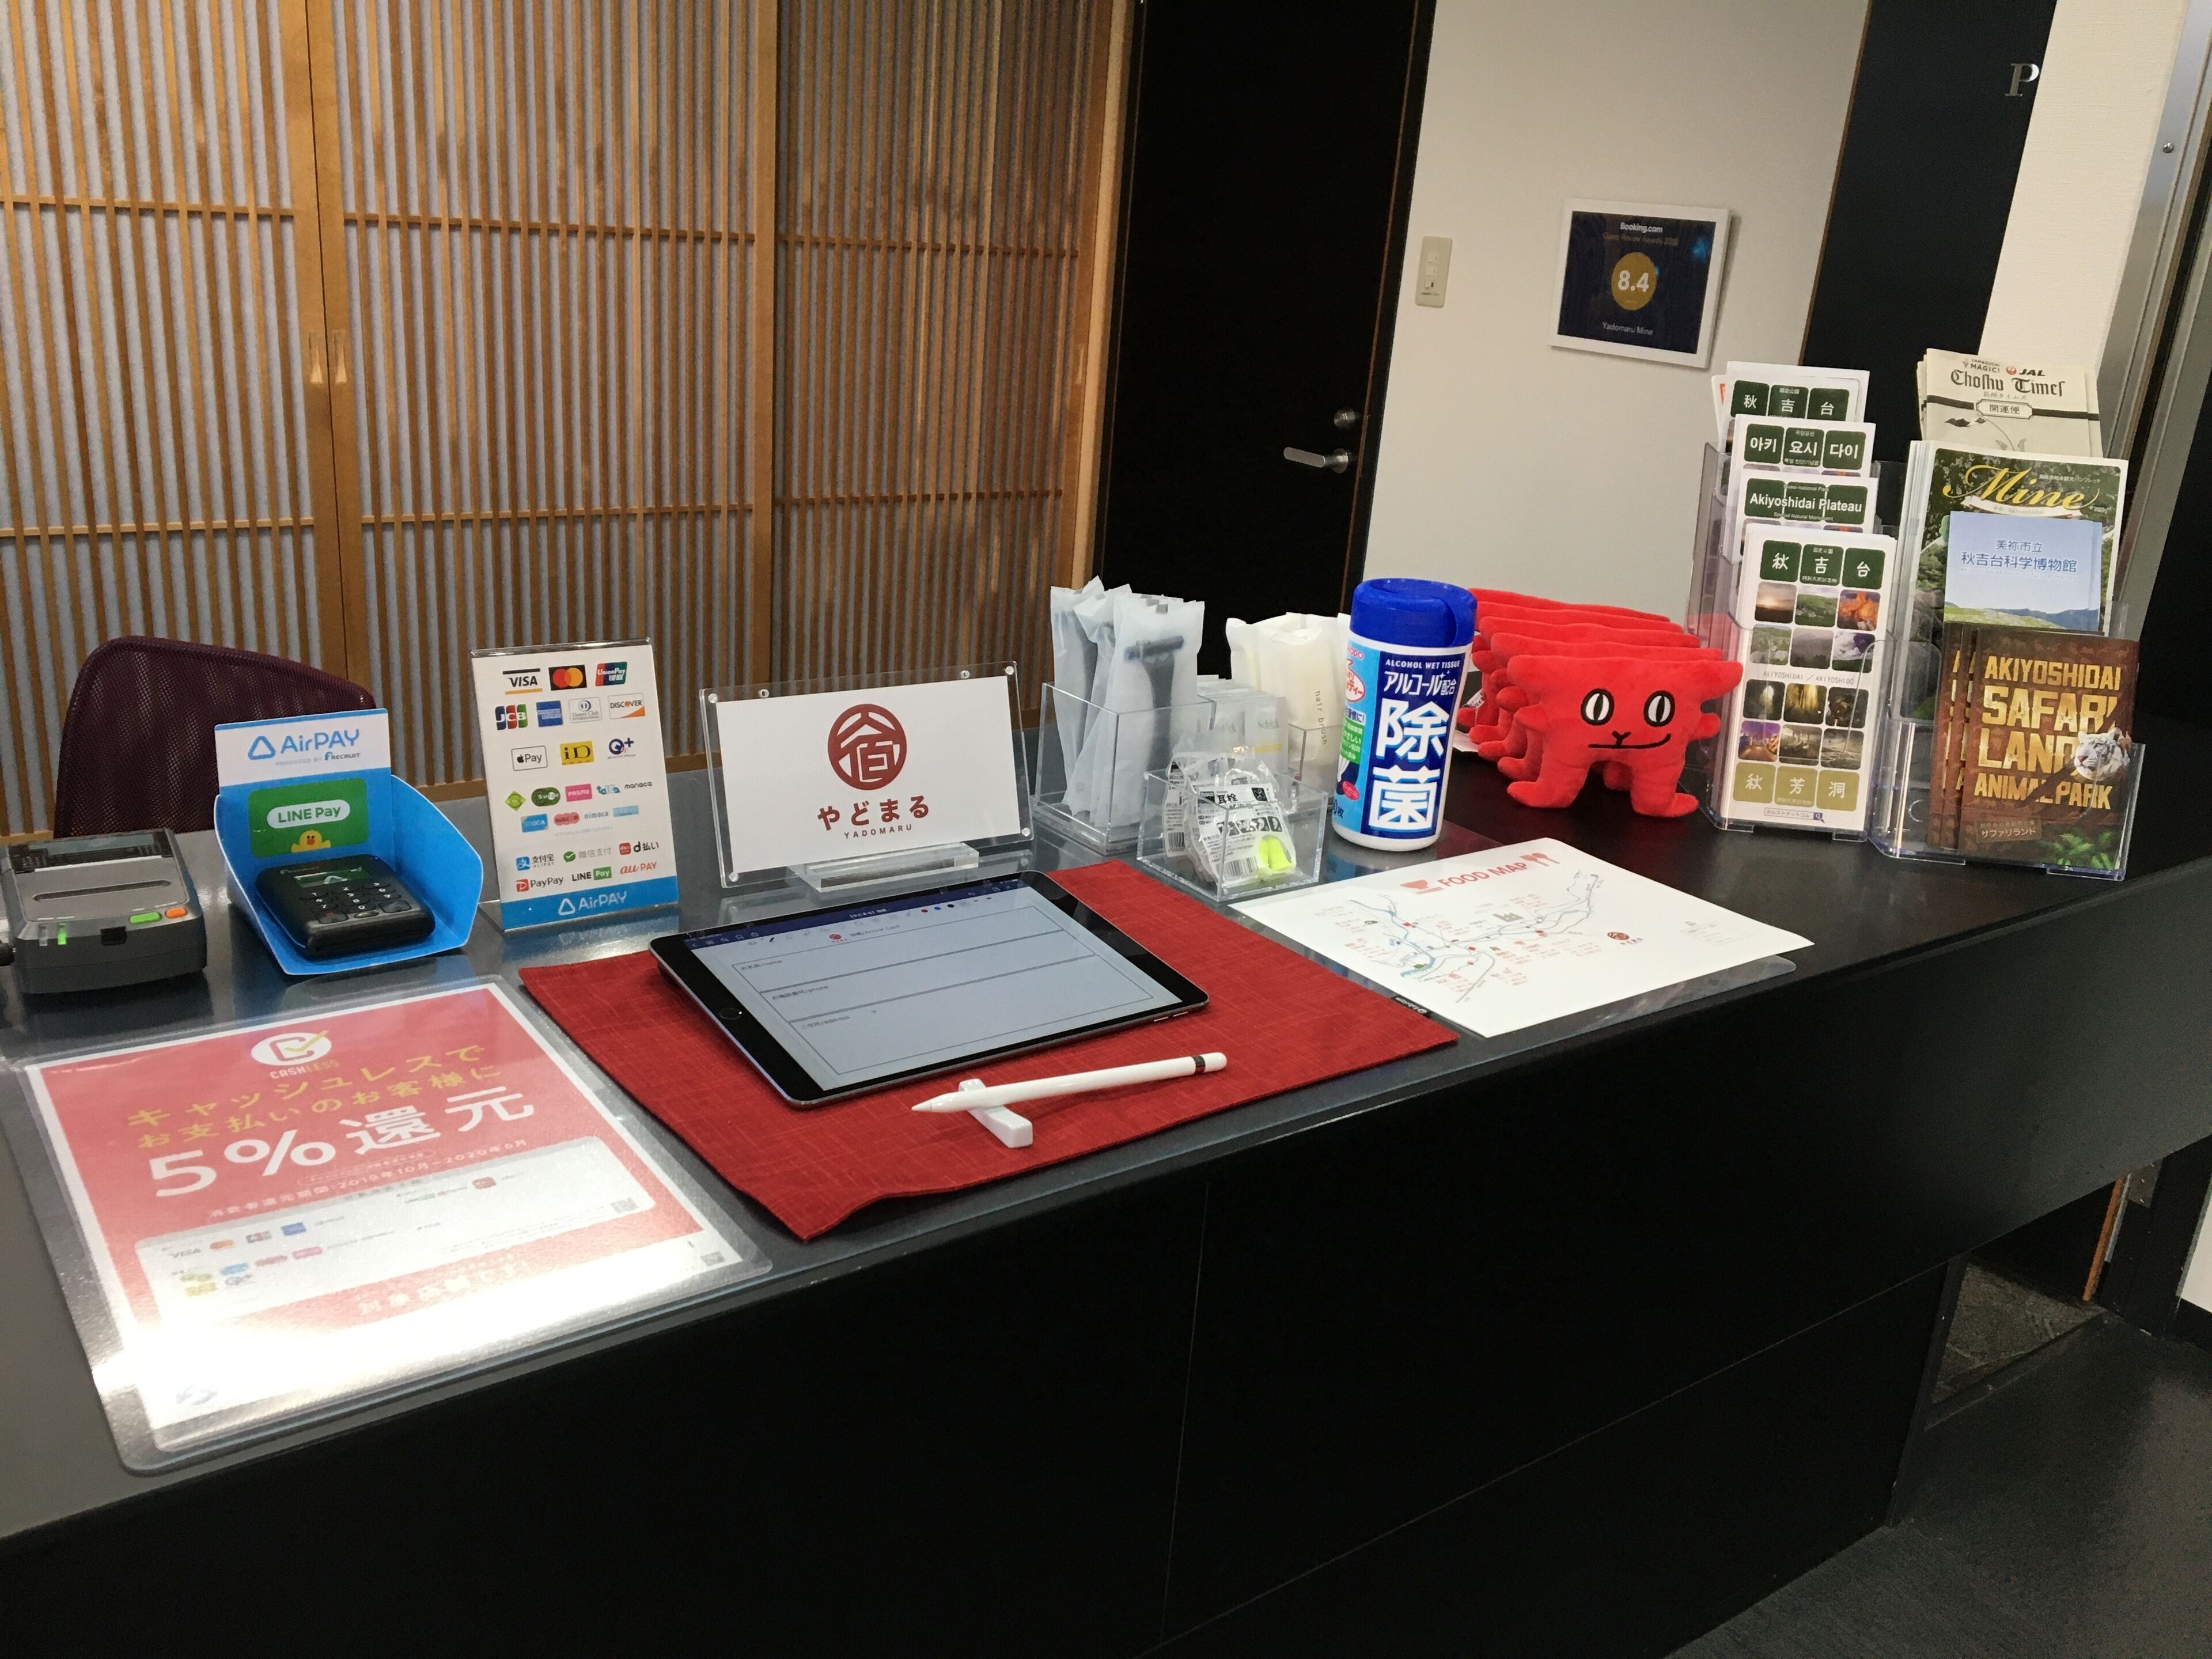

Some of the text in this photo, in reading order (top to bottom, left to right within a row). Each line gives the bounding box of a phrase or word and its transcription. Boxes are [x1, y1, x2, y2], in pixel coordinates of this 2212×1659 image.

[2004, 63, 2040, 97] P
[1620, 222, 1663, 233] Booking.com
[1618, 270, 1649, 292] 8.4
[1603, 321, 1654, 336] Yadomaru Mine
[1970, 363, 2001, 374] MAGIC!
[2018, 368, 2046, 377] JAL
[1989, 404, 2020, 415] 開運便
[1942, 464, 2100, 510] Mine
[1749, 493, 1862, 513] Akiyoshidai Plateau
[1995, 539, 2043, 553] 美祢市立
[1961, 551, 2077, 573] 秋吉台科学博物館
[1385, 658, 1422, 669] ALCOHOL
[1441, 660, 1461, 669] TISSUE
[597, 667, 626, 676] UnionPay
[1984, 655, 2121, 691] AKIYOSHIDAI
[507, 675, 538, 687] VISA
[1383, 671, 1457, 697] アルコール配合
[609, 699, 643, 709] DISCOVER
[1315, 690, 1328, 745] hair brush
[280, 728, 360, 754] AirPAY
[525, 753, 543, 764] Pay
[563, 745, 592, 760] iD
[275, 757, 312, 766] PRODUCED
[1368, 698, 1451, 831] 除菌
[624, 781, 653, 790] manaca
[1217, 793, 1238, 805] 耳栓
[2055, 781, 2114, 810] PARK
[278, 806, 342, 823] LINE Pay
[817, 794, 930, 832] やどまる
[1766, 809, 1810, 819] カルストドットコム
[844, 824, 913, 839] YADOMARU
[1982, 827, 2036, 839] サファリランド
[578, 847, 612, 859] 微信支付
[634, 842, 660, 853] d払い
[532, 854, 554, 863] 支付宝
[571, 869, 609, 881] LINE Pay
[619, 862, 658, 874] au PAY
[1437, 862, 1528, 887] FOOD MAP
[530, 877, 564, 888] PayPay
[578, 891, 627, 911] AirPAY
[269, 1059, 340, 1080] CASHLESS
[126, 1043, 486, 1128] キャッシュレスで
[138, 1065, 502, 1149] お支払いのお客様に
